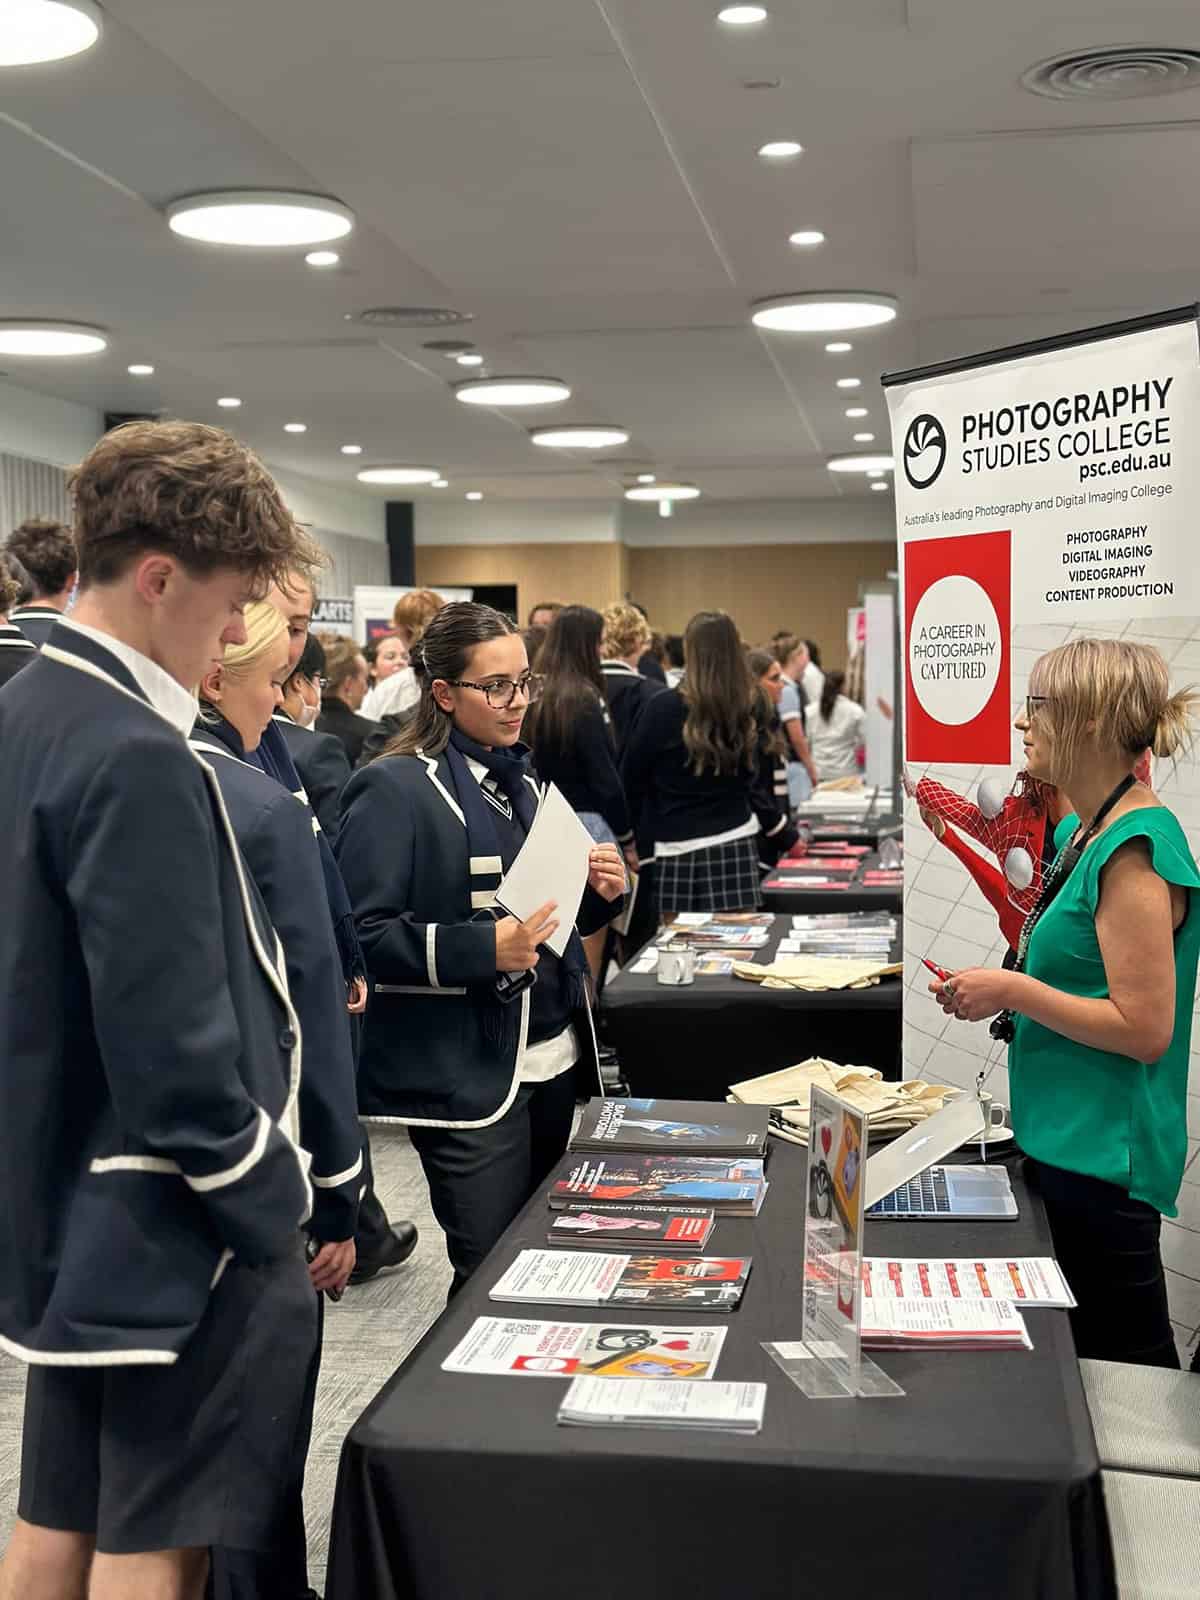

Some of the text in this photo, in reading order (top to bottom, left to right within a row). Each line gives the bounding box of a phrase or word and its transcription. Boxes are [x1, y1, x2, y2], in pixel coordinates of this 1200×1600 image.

[962, 377, 1173, 443] PHOTOGRAPHY
[961, 417, 1170, 473] STUDIES COLLEGE
[1079, 453, 1171, 482] psc.edu.au
[903, 483, 1173, 526] Australia's leading Photography and Digital Imaging College
[1066, 525, 1148, 545] PHOTOGRAPHY
[1062, 544, 1153, 564] DIGITAL IMAGING
[1068, 564, 1146, 582] VIDEOGRAPHY
[1045, 582, 1174, 602] CONTENT PRODUCTION
[919, 624, 986, 641] A CAREER IN
[913, 642, 996, 658] PHOTOGRAPHY
[920, 661, 986, 680] CAPTURED
[590, 1101, 615, 1139] PHOTOGY
